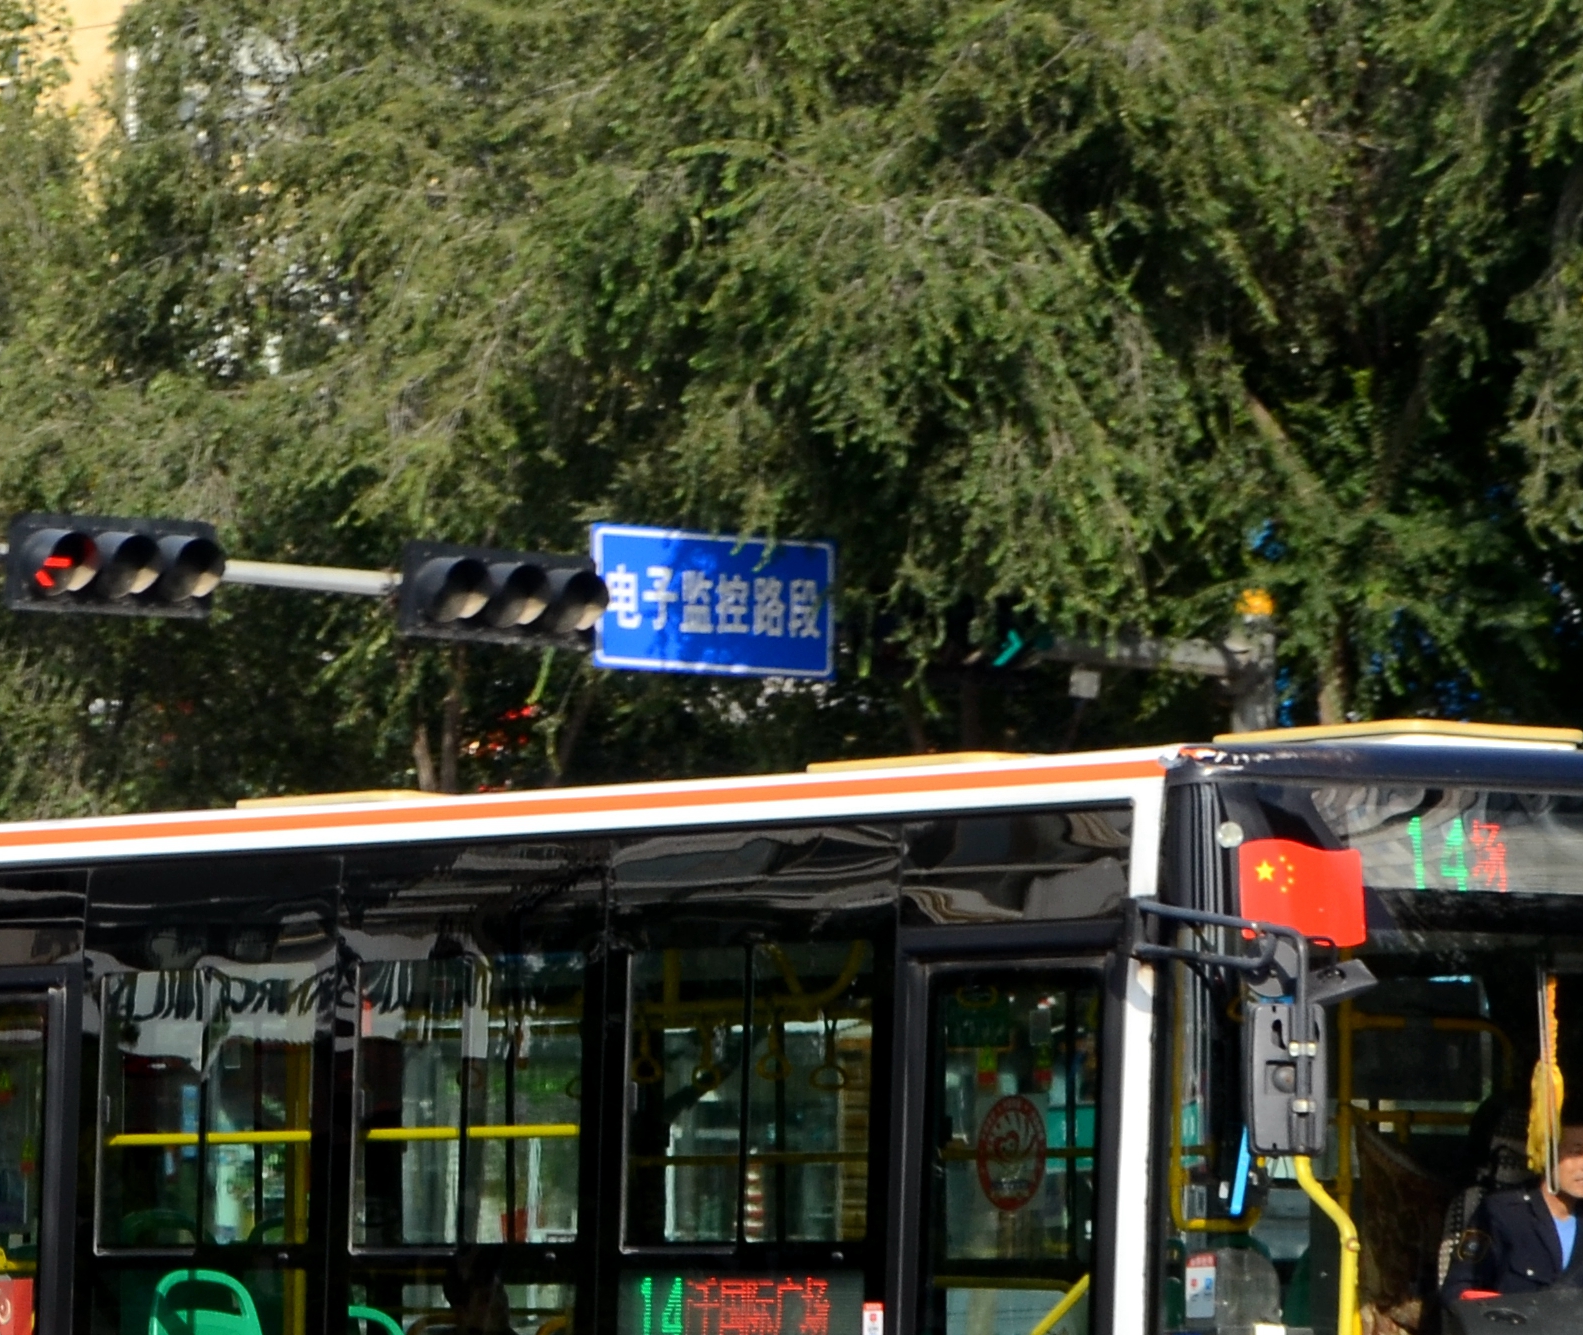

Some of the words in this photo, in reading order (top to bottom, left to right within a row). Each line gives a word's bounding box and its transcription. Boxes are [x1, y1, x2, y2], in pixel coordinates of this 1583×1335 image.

[605, 563, 821, 638] 电子监控路段
[1407, 816, 1468, 891] 14
